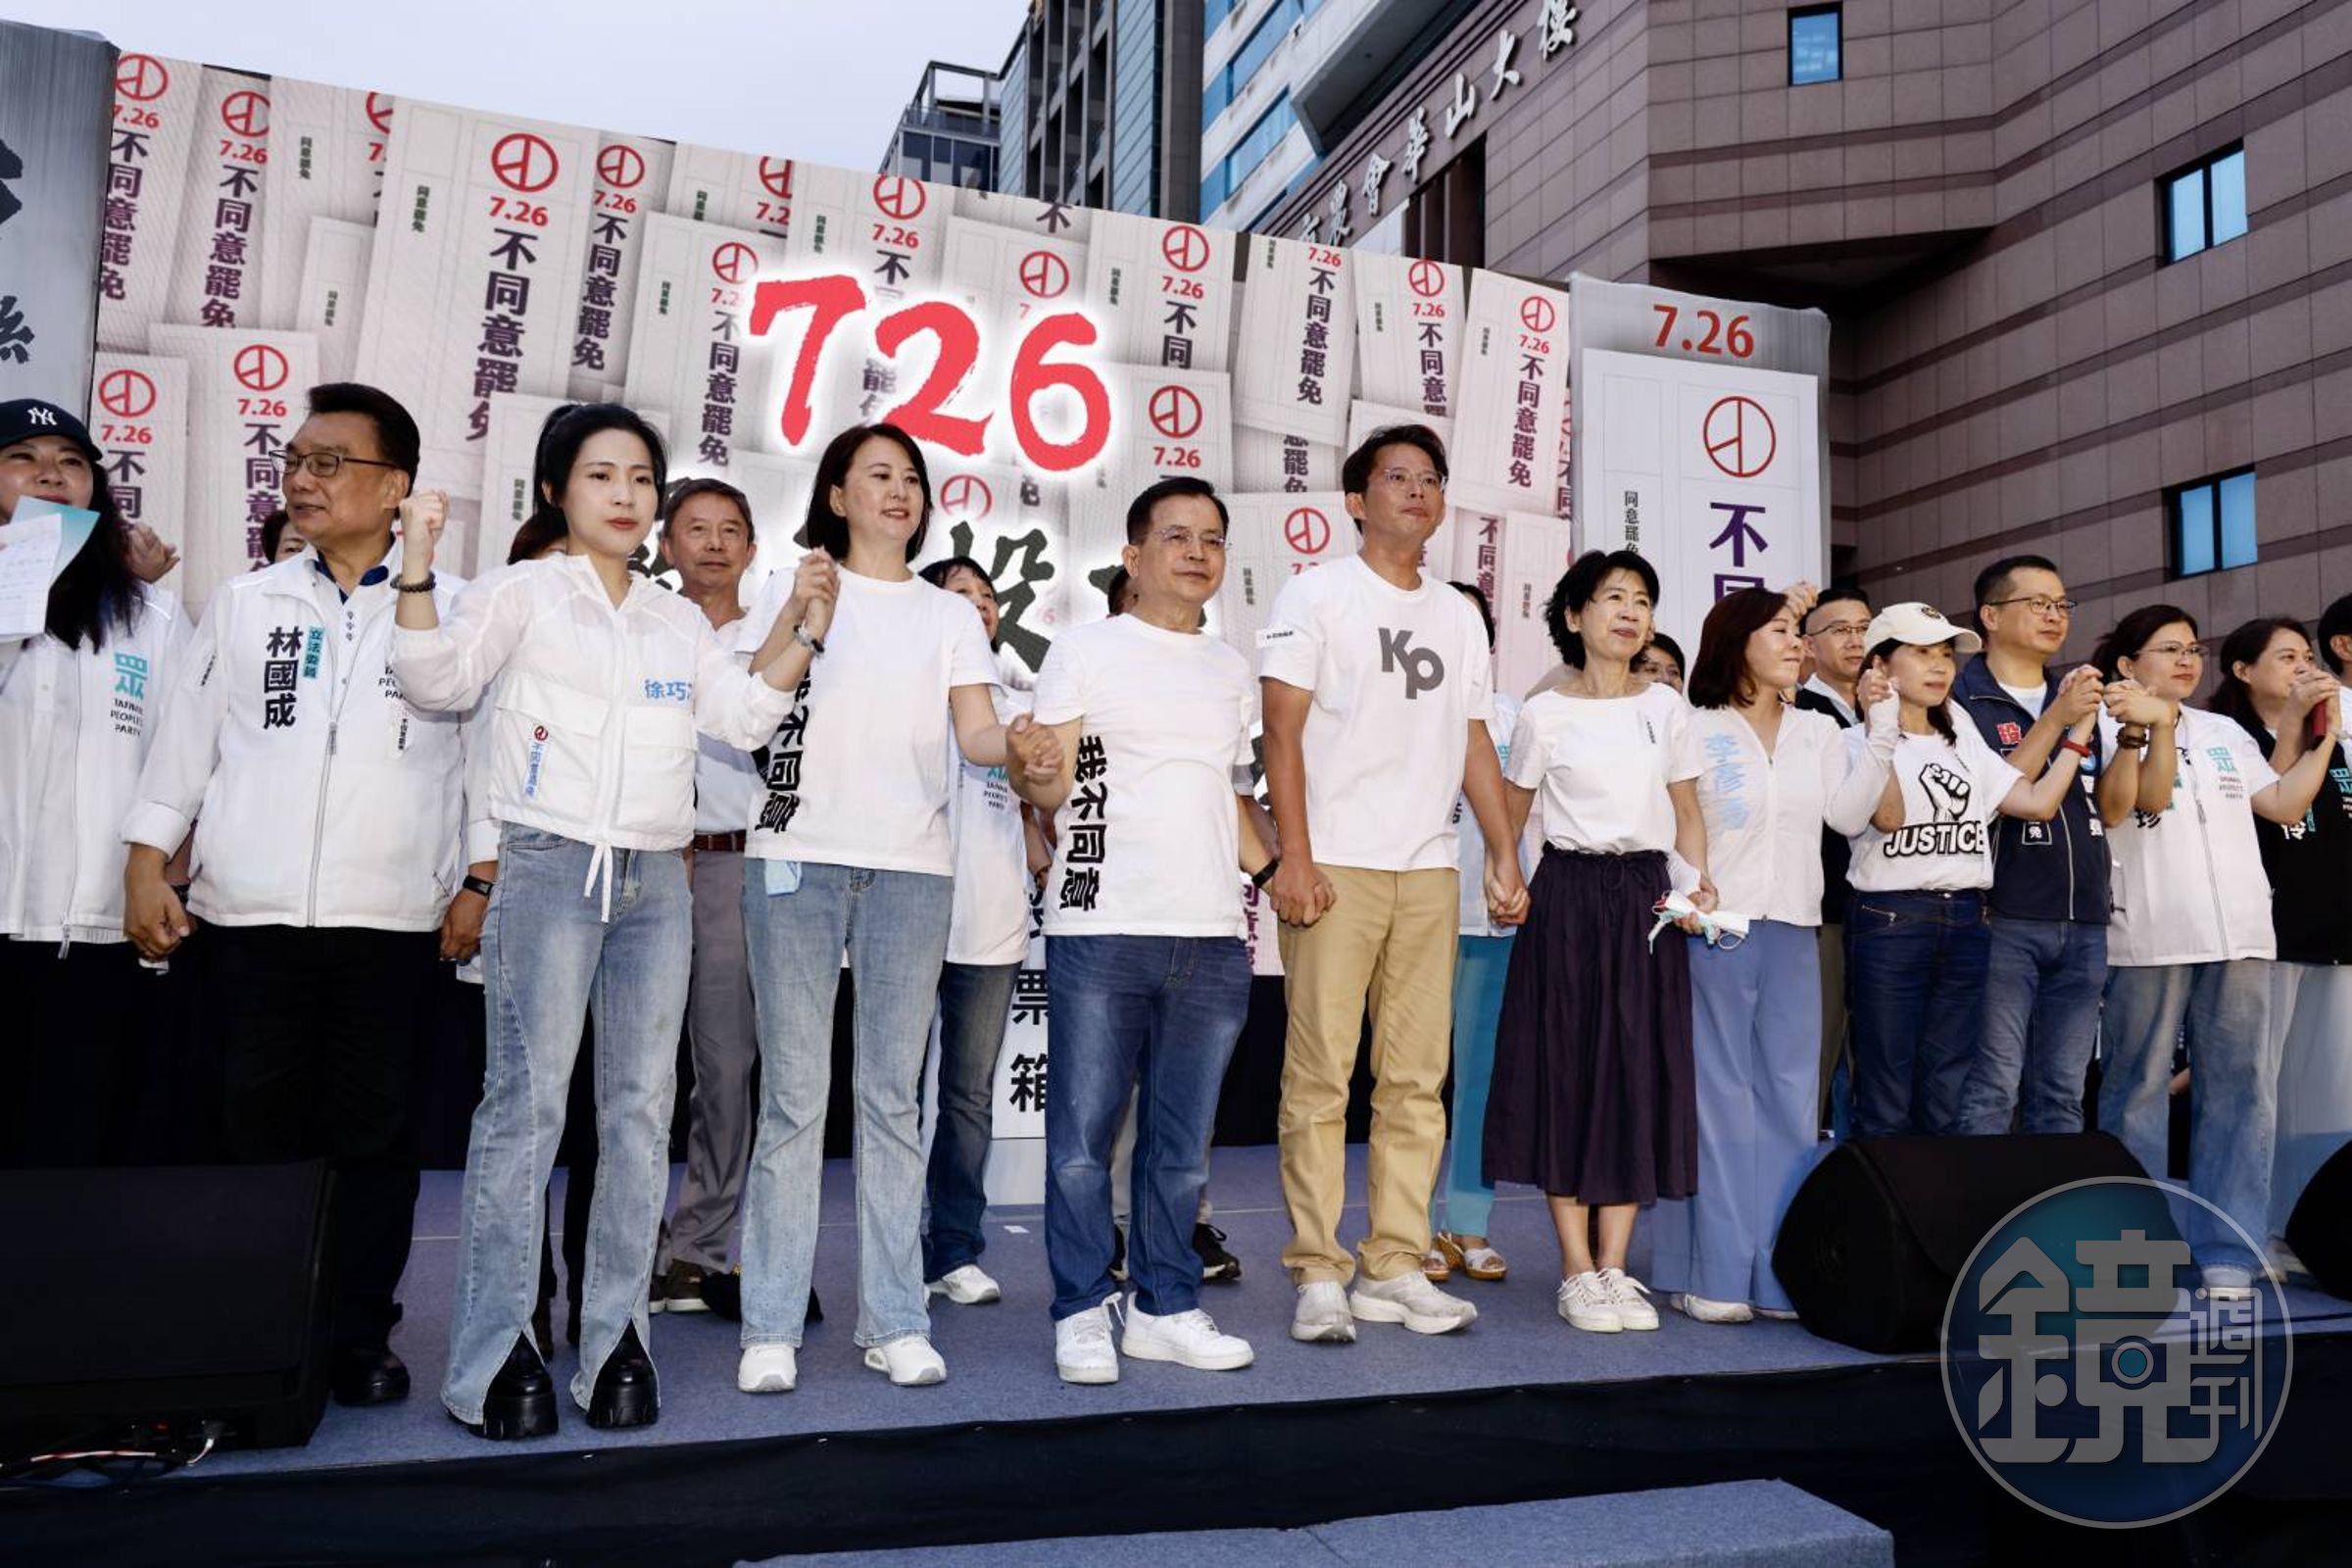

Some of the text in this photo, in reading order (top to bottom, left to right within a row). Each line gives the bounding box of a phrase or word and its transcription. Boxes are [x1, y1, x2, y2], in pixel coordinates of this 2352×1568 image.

[220, 140, 268, 164] 7.26
[489, 196, 550, 227] 7.26
[593, 190, 636, 214] 7.26
[200, 165, 259, 328] 不同意罷免
[872, 223, 919, 249] 7.26
[1308, 247, 1342, 268] 7.26
[571, 213, 629, 370] 不同意罷免
[1161, 276, 1203, 300] 7.26
[1412, 302, 1446, 318] 7.26
[1297, 267, 1336, 406] 不同意罷免
[1519, 334, 1550, 355] 7.26
[1653, 304, 1754, 359] 7.26
[750, 274, 1111, 470] 726
[238, 399, 287, 417] 7.26
[1507, 354, 1545, 488] 不同意罷免
[101, 424, 153, 444] 7.26
[1152, 446, 1201, 468] 7.26
[244, 423, 282, 571] 不同意罷
[264, 626, 304, 730] 林國成
[645, 679, 692, 701] 徐巧
[1059, 735, 1108, 911] 我不同意
[1884, 819, 1985, 858] JUSTICE
